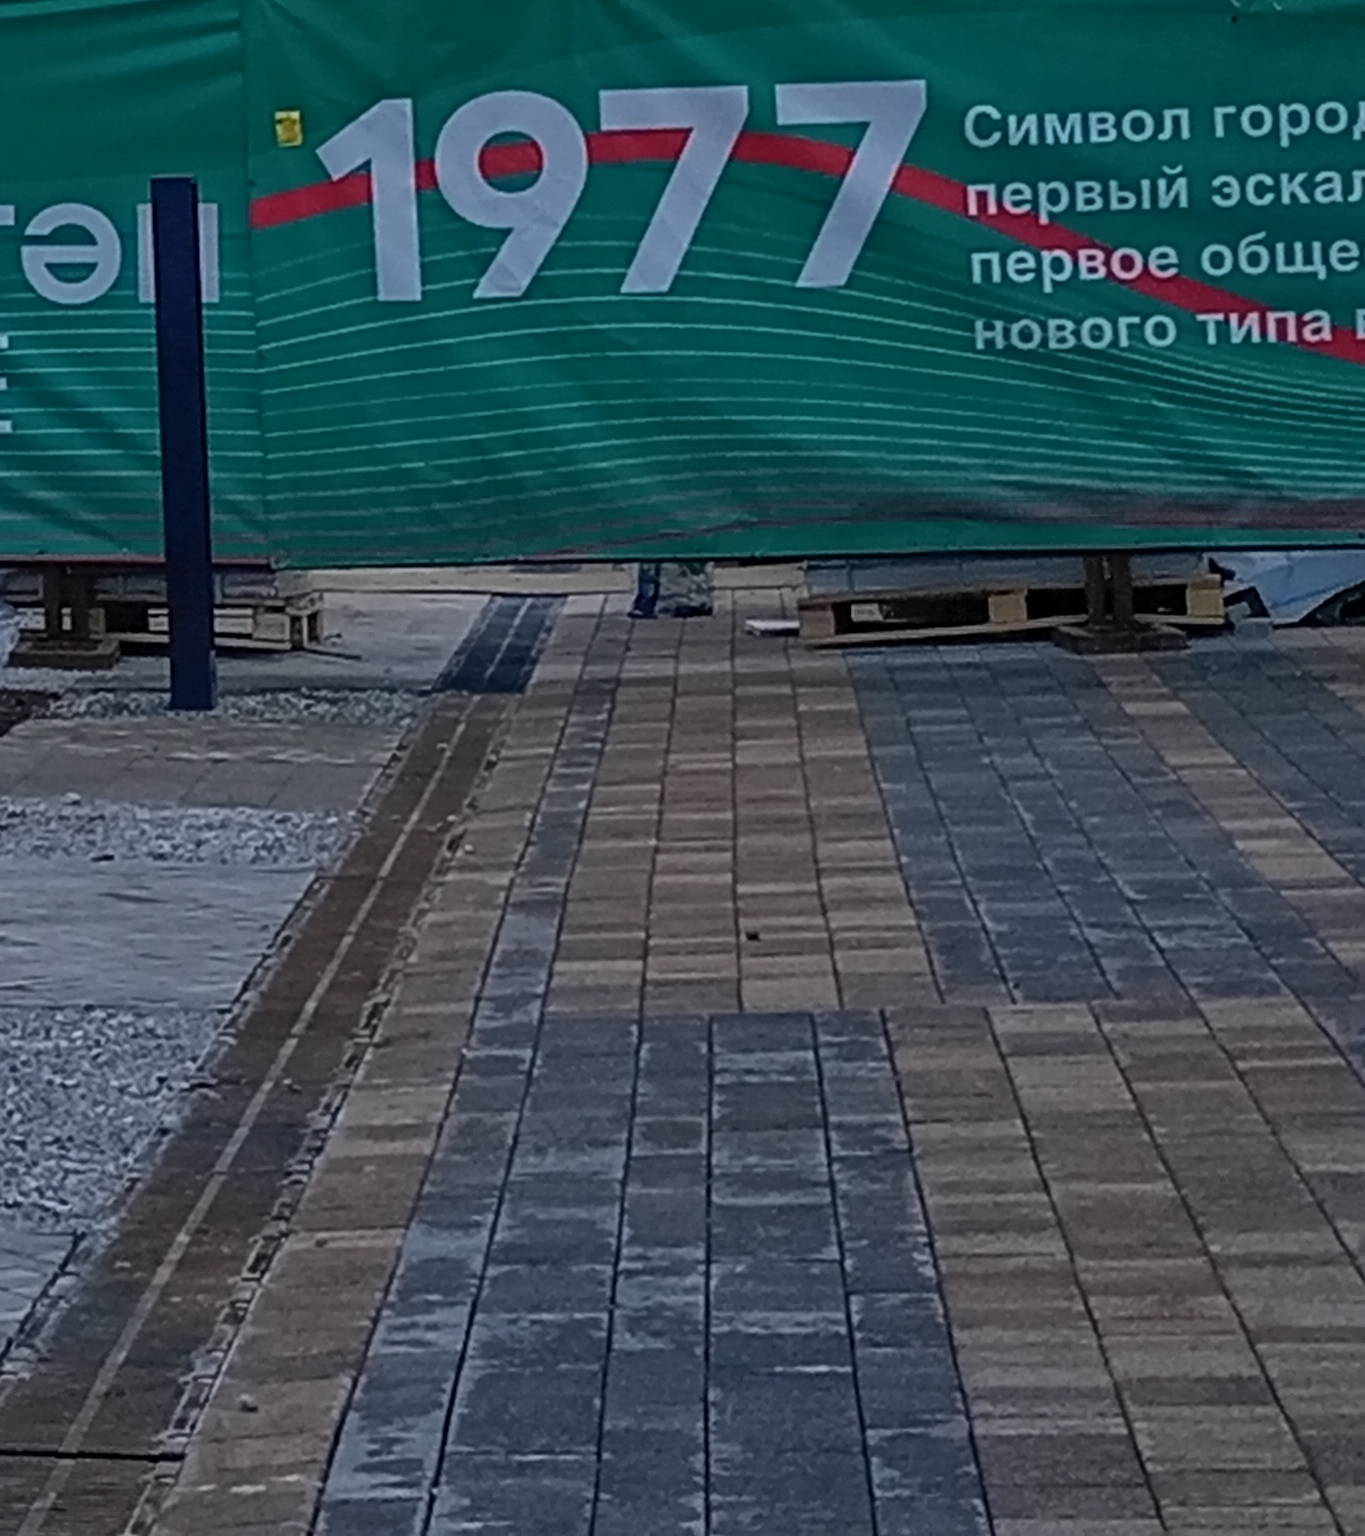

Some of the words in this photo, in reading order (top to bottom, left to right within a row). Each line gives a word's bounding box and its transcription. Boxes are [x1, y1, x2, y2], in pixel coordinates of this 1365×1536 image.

[963, 104, 1191, 148] Символ
[314, 79, 927, 302] 1977
[966, 164, 1189, 225] первый
[971, 244, 1179, 294] первое
[974, 314, 1177, 350] нового
[1195, 309, 1333, 345] типа
